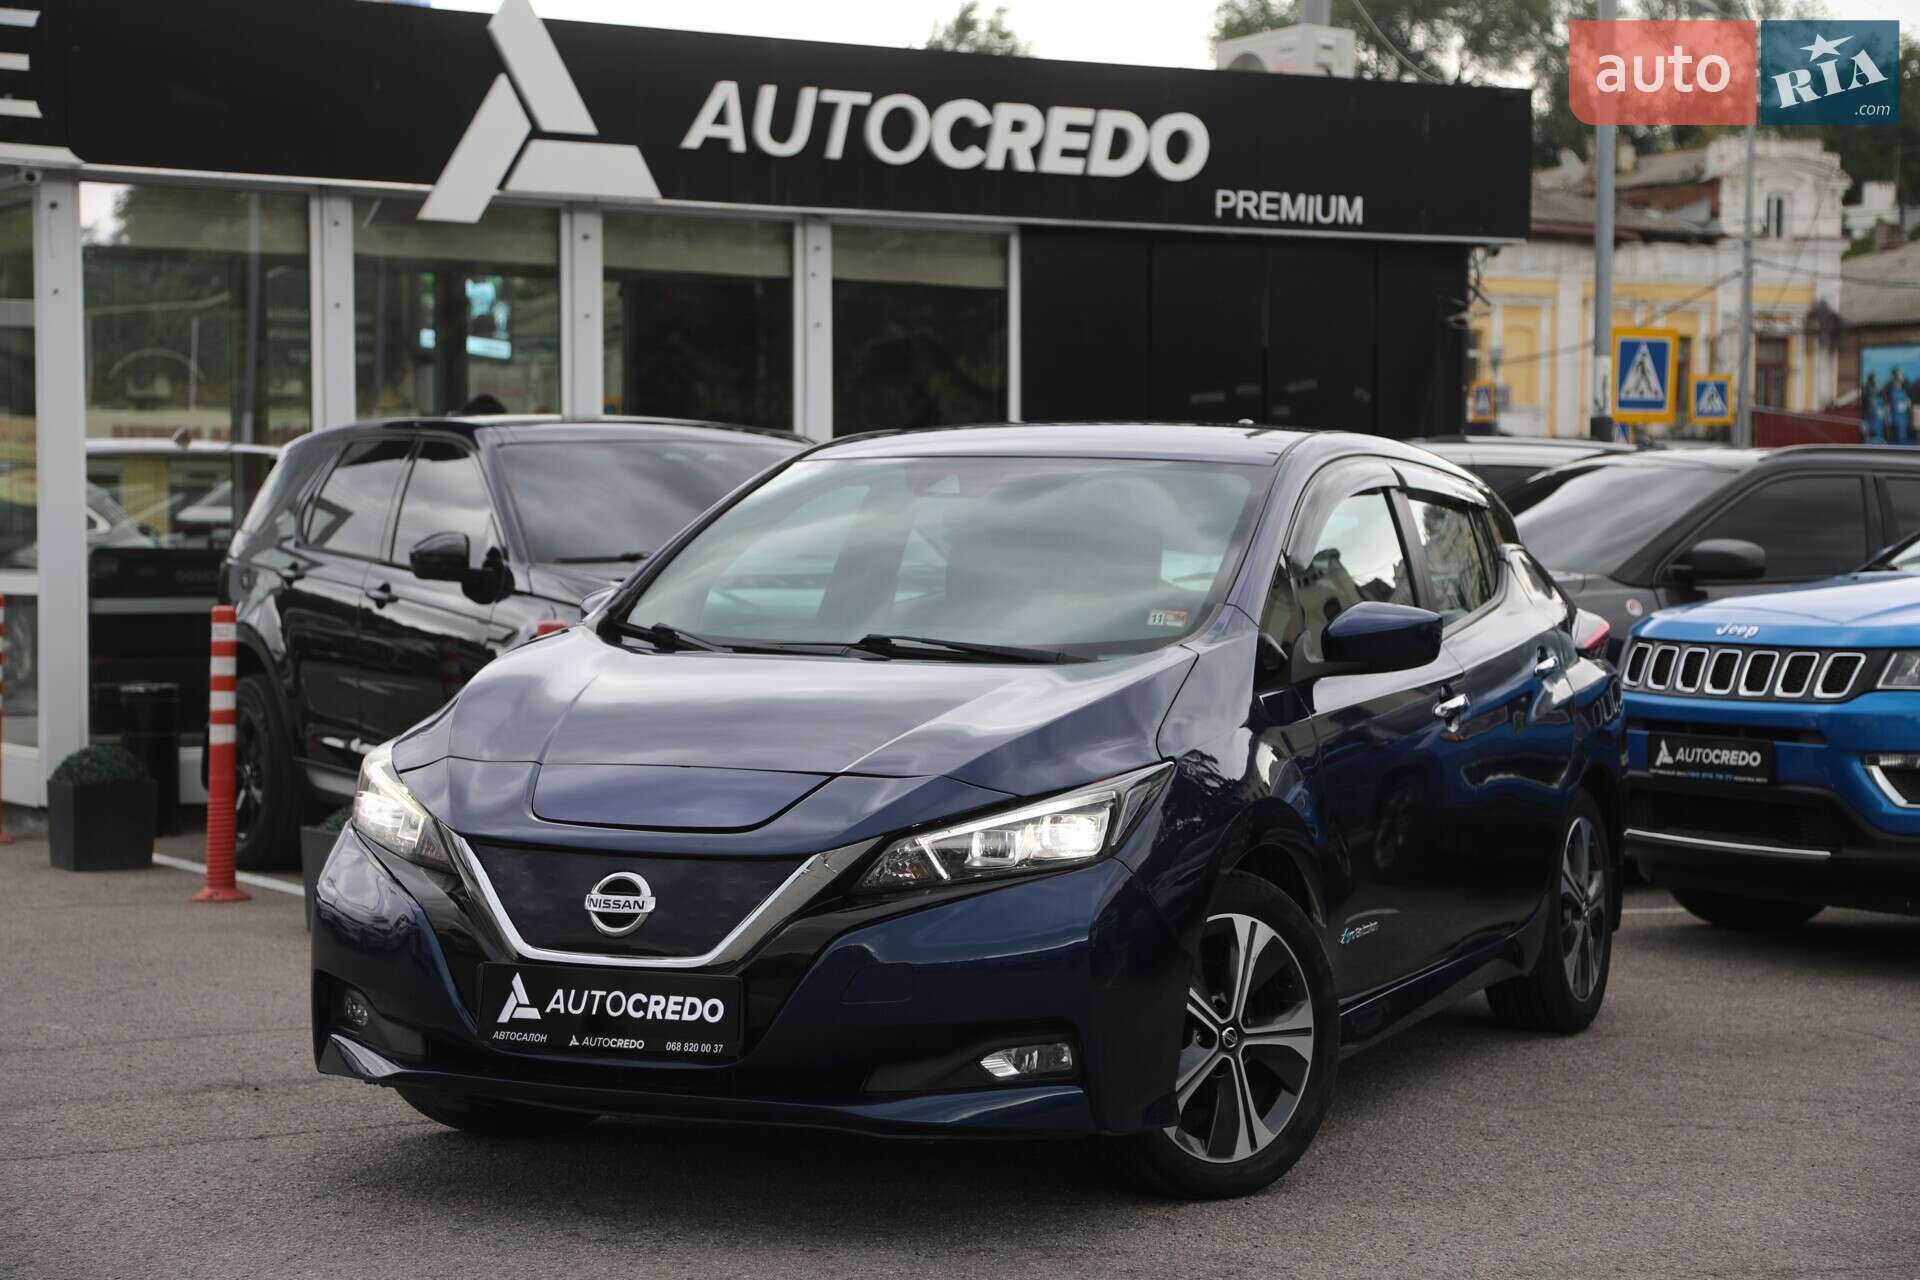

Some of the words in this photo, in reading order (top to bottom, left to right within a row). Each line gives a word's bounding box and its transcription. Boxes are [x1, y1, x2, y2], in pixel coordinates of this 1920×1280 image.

[680, 80, 1211, 182] AUTOCREDO
[1214, 188, 1364, 225] PREMIUM
[1715, 623, 1761, 639] Jeep
[1675, 746, 1762, 767] AUTOCREDO
[588, 897, 646, 911] NISSAN
[545, 988, 725, 1024] AUTOCREDO
[492, 1031, 548, 1043] АВТОСАЛОН
[581, 1036, 645, 1050] AUTOCREDO
[665, 1042, 682, 1052] 068
[683, 1042, 699, 1053] 820
[700, 1043, 712, 1053] 00
[712, 1044, 724, 1054] 37
